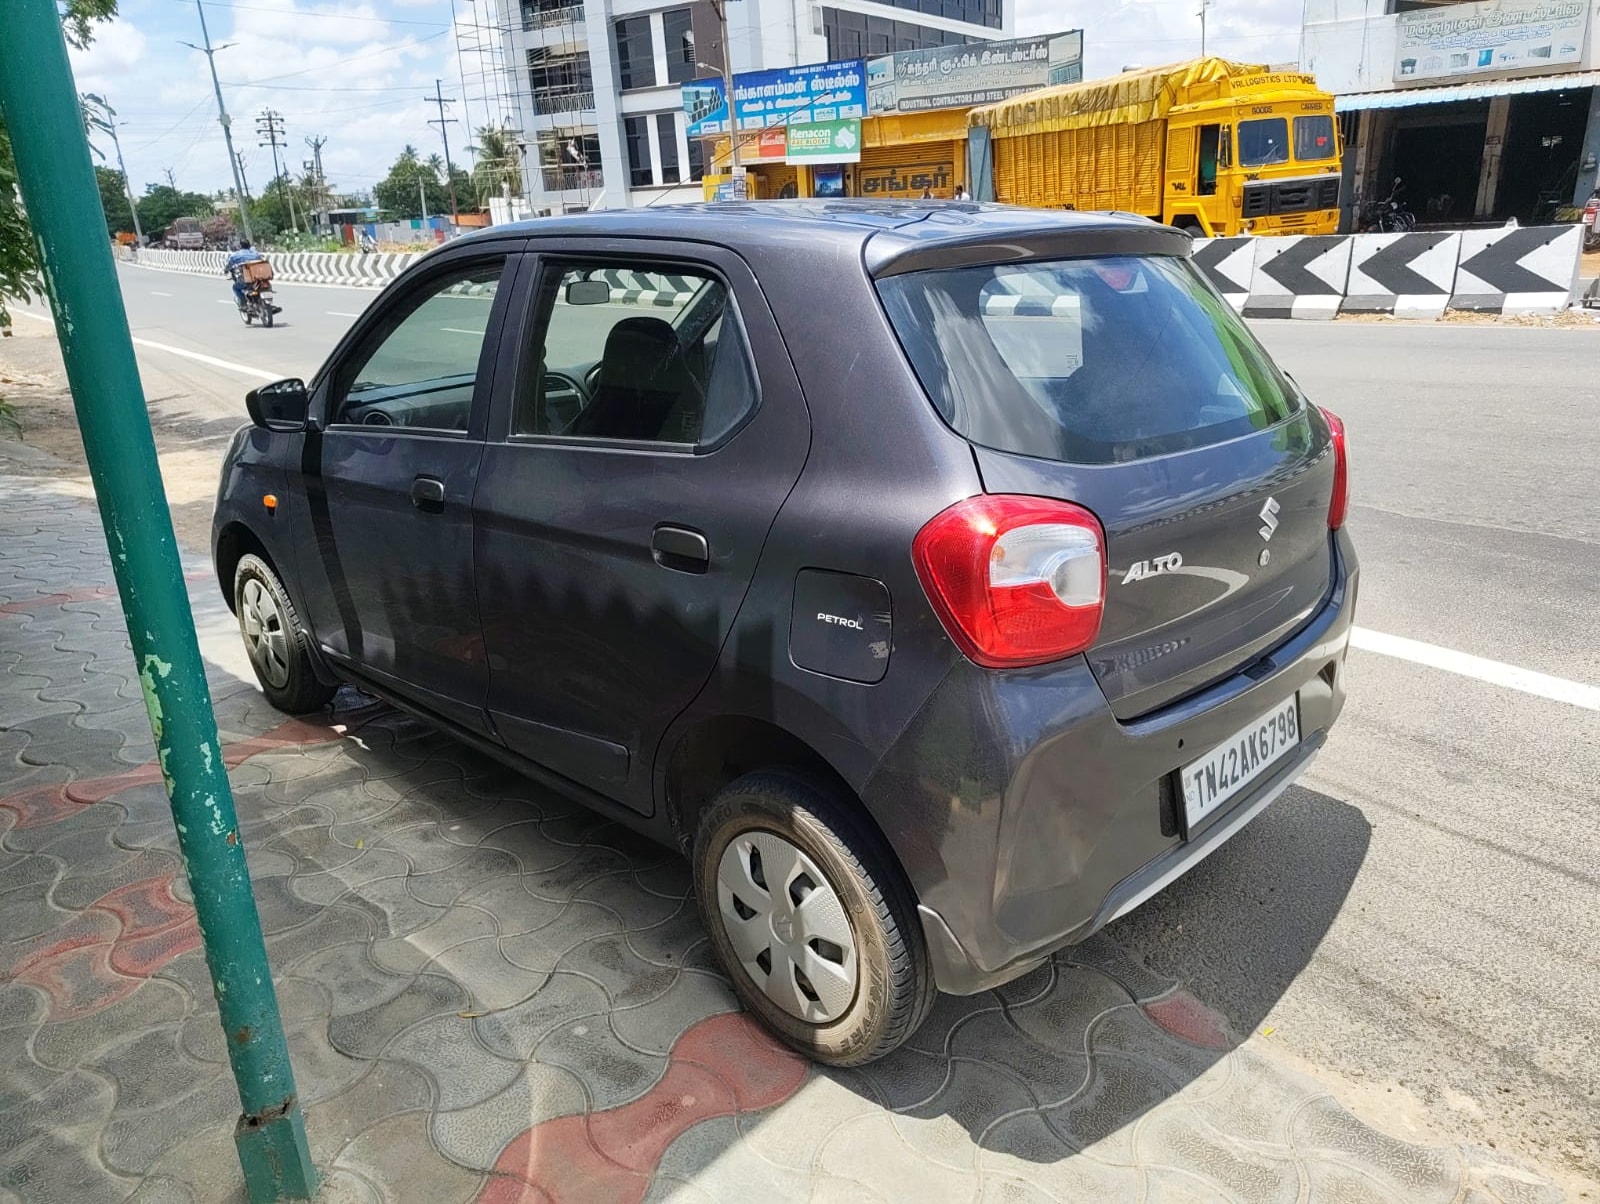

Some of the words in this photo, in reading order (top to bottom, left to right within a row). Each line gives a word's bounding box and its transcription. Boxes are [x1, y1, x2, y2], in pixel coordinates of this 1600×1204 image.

[724, 77, 807, 101] ங்காளம்மன்
[1246, 75, 1281, 87] LOGISTICS
[1284, 75, 1297, 83] LTD
[932, 94, 973, 106] CONTRACTORS
[986, 90, 1004, 101] STEEL
[1251, 105, 1273, 114] GOODS
[1300, 102, 1323, 111] CARRIER
[790, 128, 831, 139] Renacon
[1121, 551, 1183, 585] ALTO
[817, 612, 864, 630] PETROL
[1193, 704, 1297, 809] TN42AK6798
